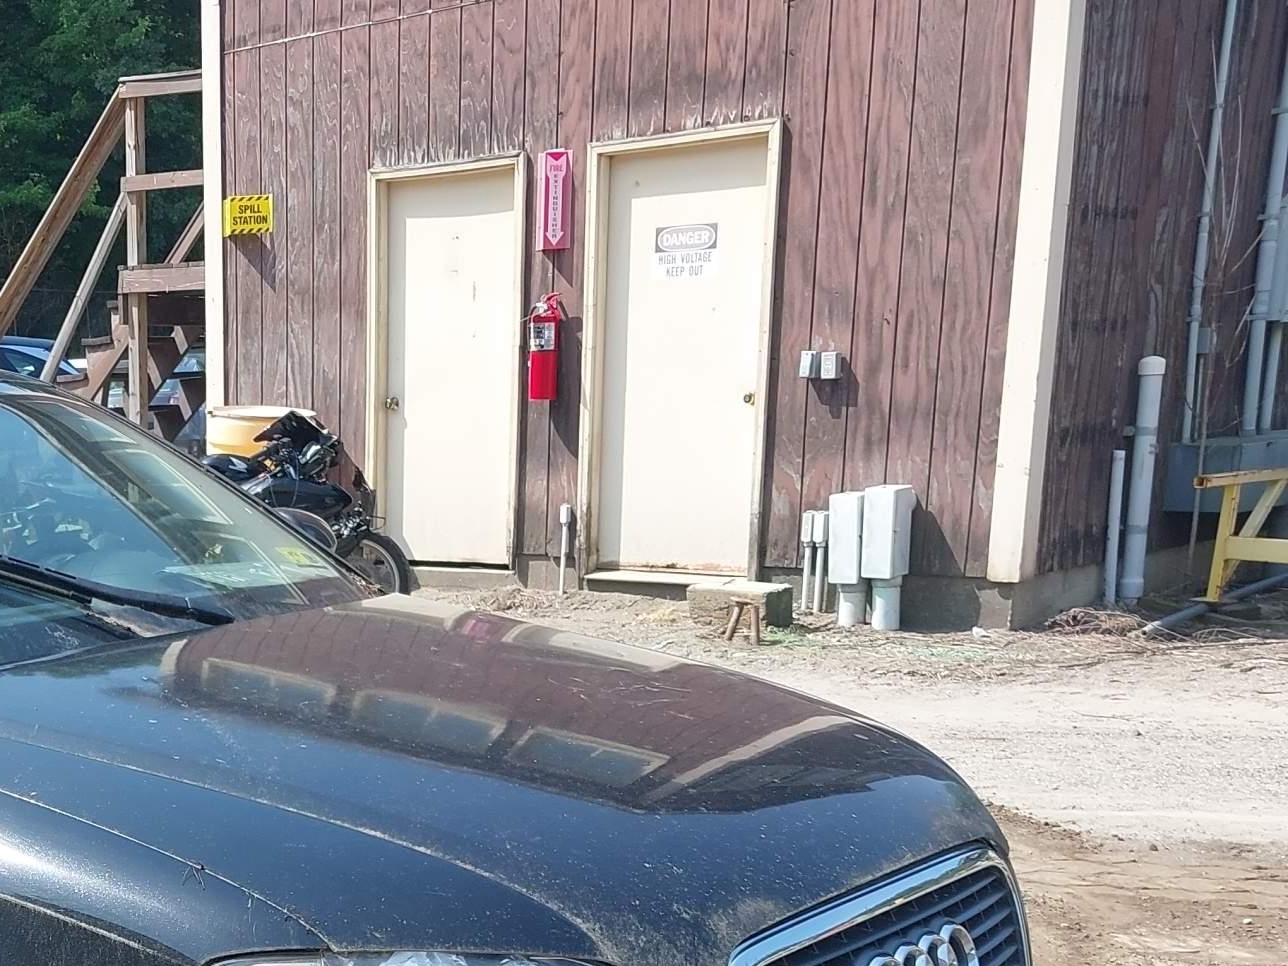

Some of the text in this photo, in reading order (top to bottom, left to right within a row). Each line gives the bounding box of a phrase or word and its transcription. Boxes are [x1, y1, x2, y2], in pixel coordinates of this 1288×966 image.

[238, 203, 263, 214] SPILL
[232, 214, 268, 226] STATION
[662, 230, 710, 247] DANGER
[658, 251, 712, 265] HIGH VOLTAGE
[666, 264, 703, 277] KEEP OUT
